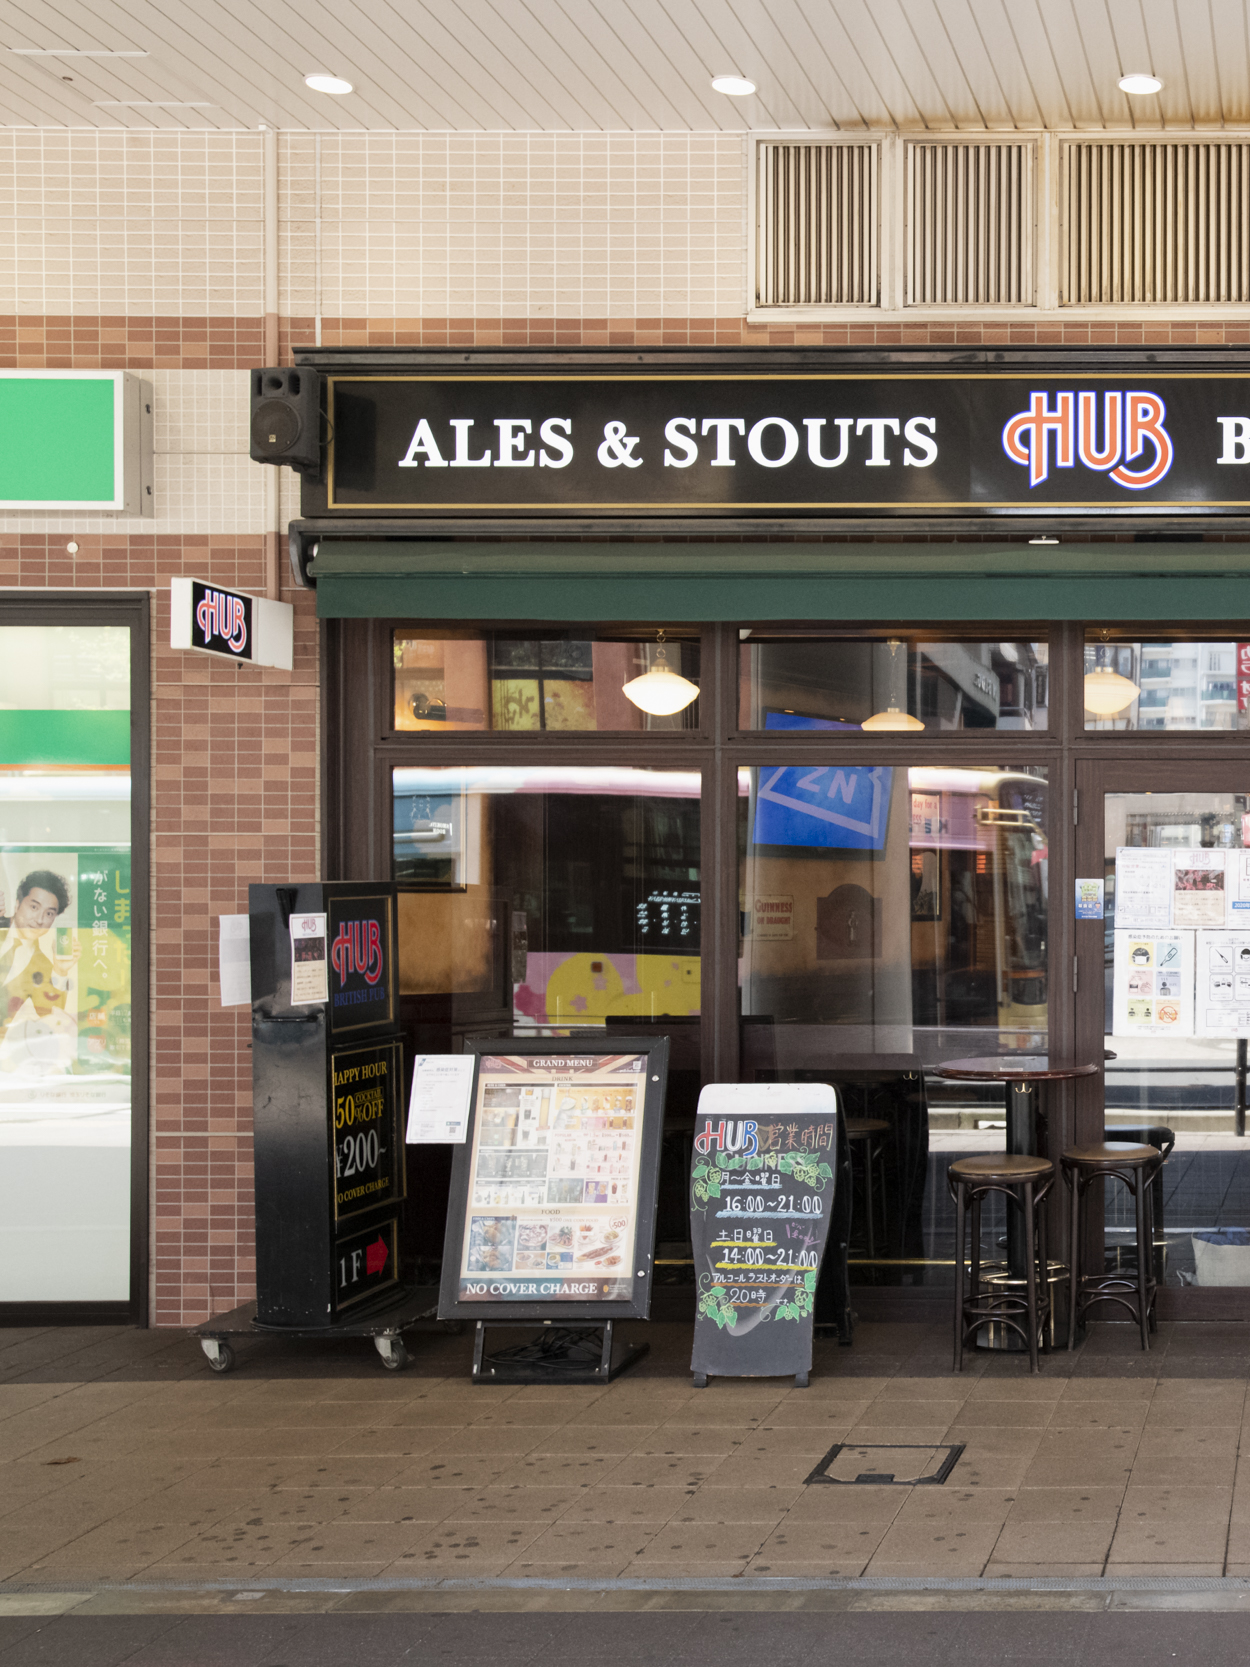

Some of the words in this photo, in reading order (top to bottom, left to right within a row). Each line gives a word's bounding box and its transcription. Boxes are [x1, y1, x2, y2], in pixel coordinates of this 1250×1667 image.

[398, 417, 574, 468] ALES
[597, 420, 643, 468] &
[663, 416, 938, 468] STOUTS
[1001, 390, 1174, 490] HUB
[196, 588, 247, 653] HUB
[755, 899, 793, 914] GUINNESS
[92, 870, 109, 979] がない銀行へ。
[301, 918, 317, 932] HUB
[331, 919, 383, 989] HUB
[333, 988, 368, 1007] BRITISH
[368, 987, 385, 1001] PUB
[361, 1061, 387, 1080] HOUR
[533, 1059, 565, 1067] GRAND
[566, 1059, 593, 1067] MENU
[355, 1086, 383, 1104] COCKTAIL
[335, 1094, 355, 1129] 50
[694, 1120, 759, 1157] HUB
[769, 1122, 834, 1151] 営業時間
[344, 1185, 365, 1202] COVER
[365, 1176, 389, 1194] CHARGE
[466, 1283, 488, 1295] NO
[489, 1283, 543, 1295] COVER
[544, 1283, 598, 1295] CHARGE
[711, 1272, 746, 1283] アルコール
[729, 1287, 767, 1303] 20時
